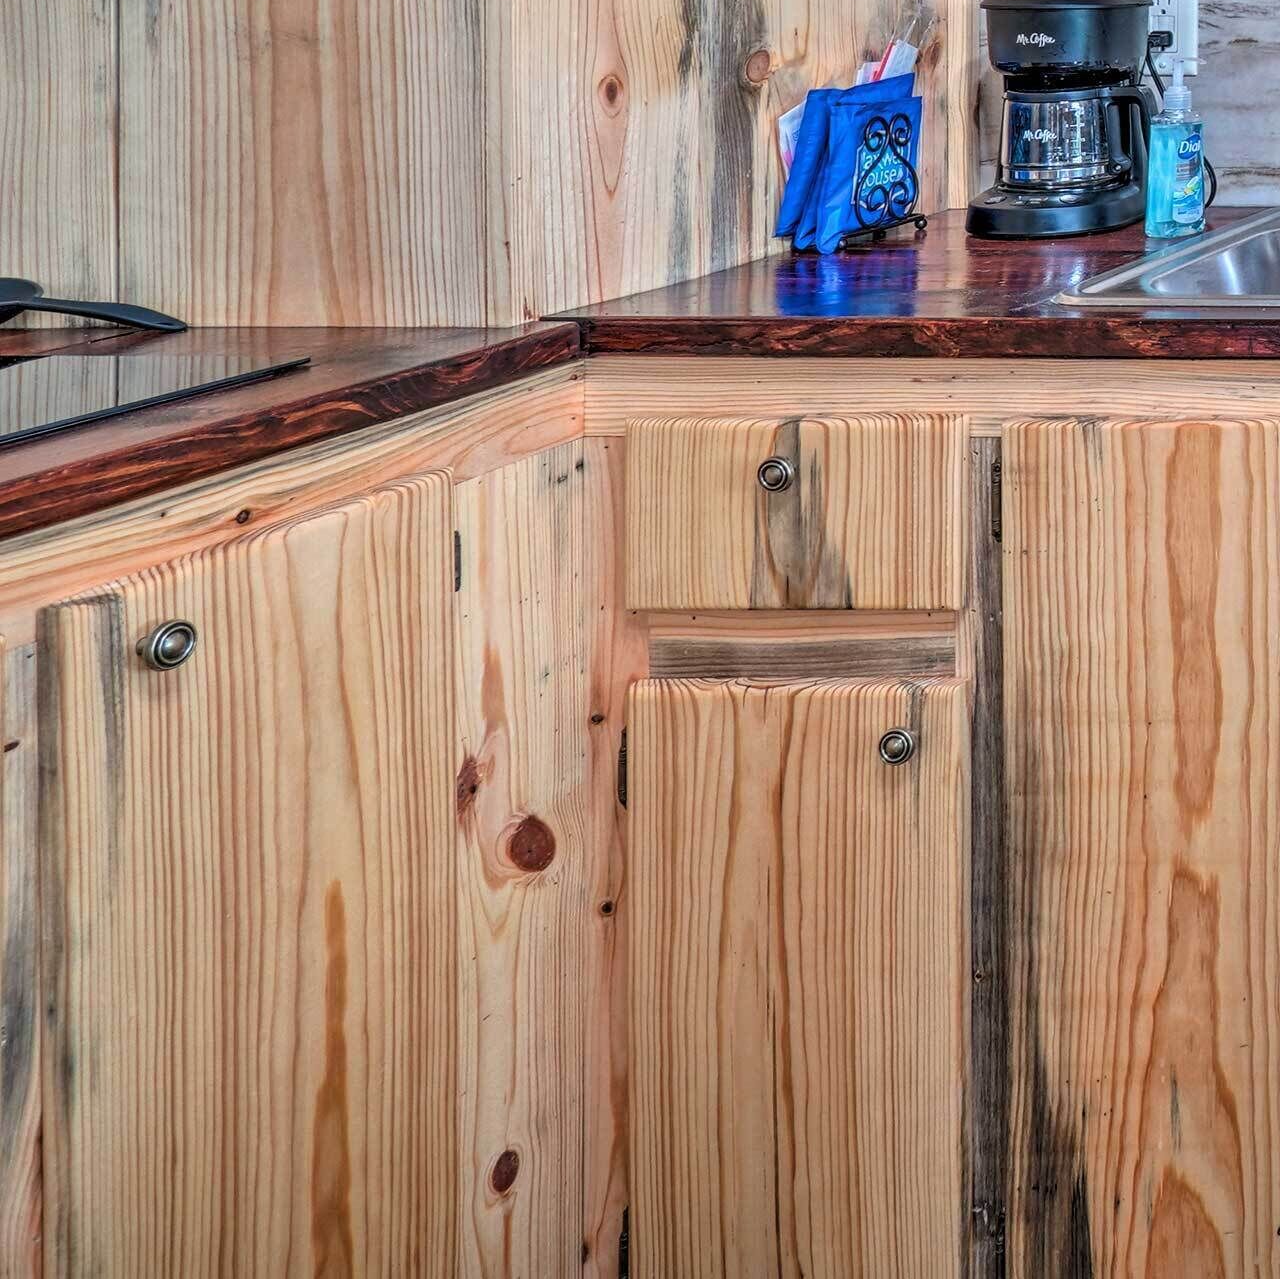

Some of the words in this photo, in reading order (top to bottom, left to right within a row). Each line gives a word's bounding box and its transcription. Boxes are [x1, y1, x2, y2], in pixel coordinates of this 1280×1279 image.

[1030, 32, 1056, 48] Coffee
[1034, 129, 1058, 144] Coffee
[1179, 140, 1200, 154] Dial
[862, 169, 898, 189] ouse
